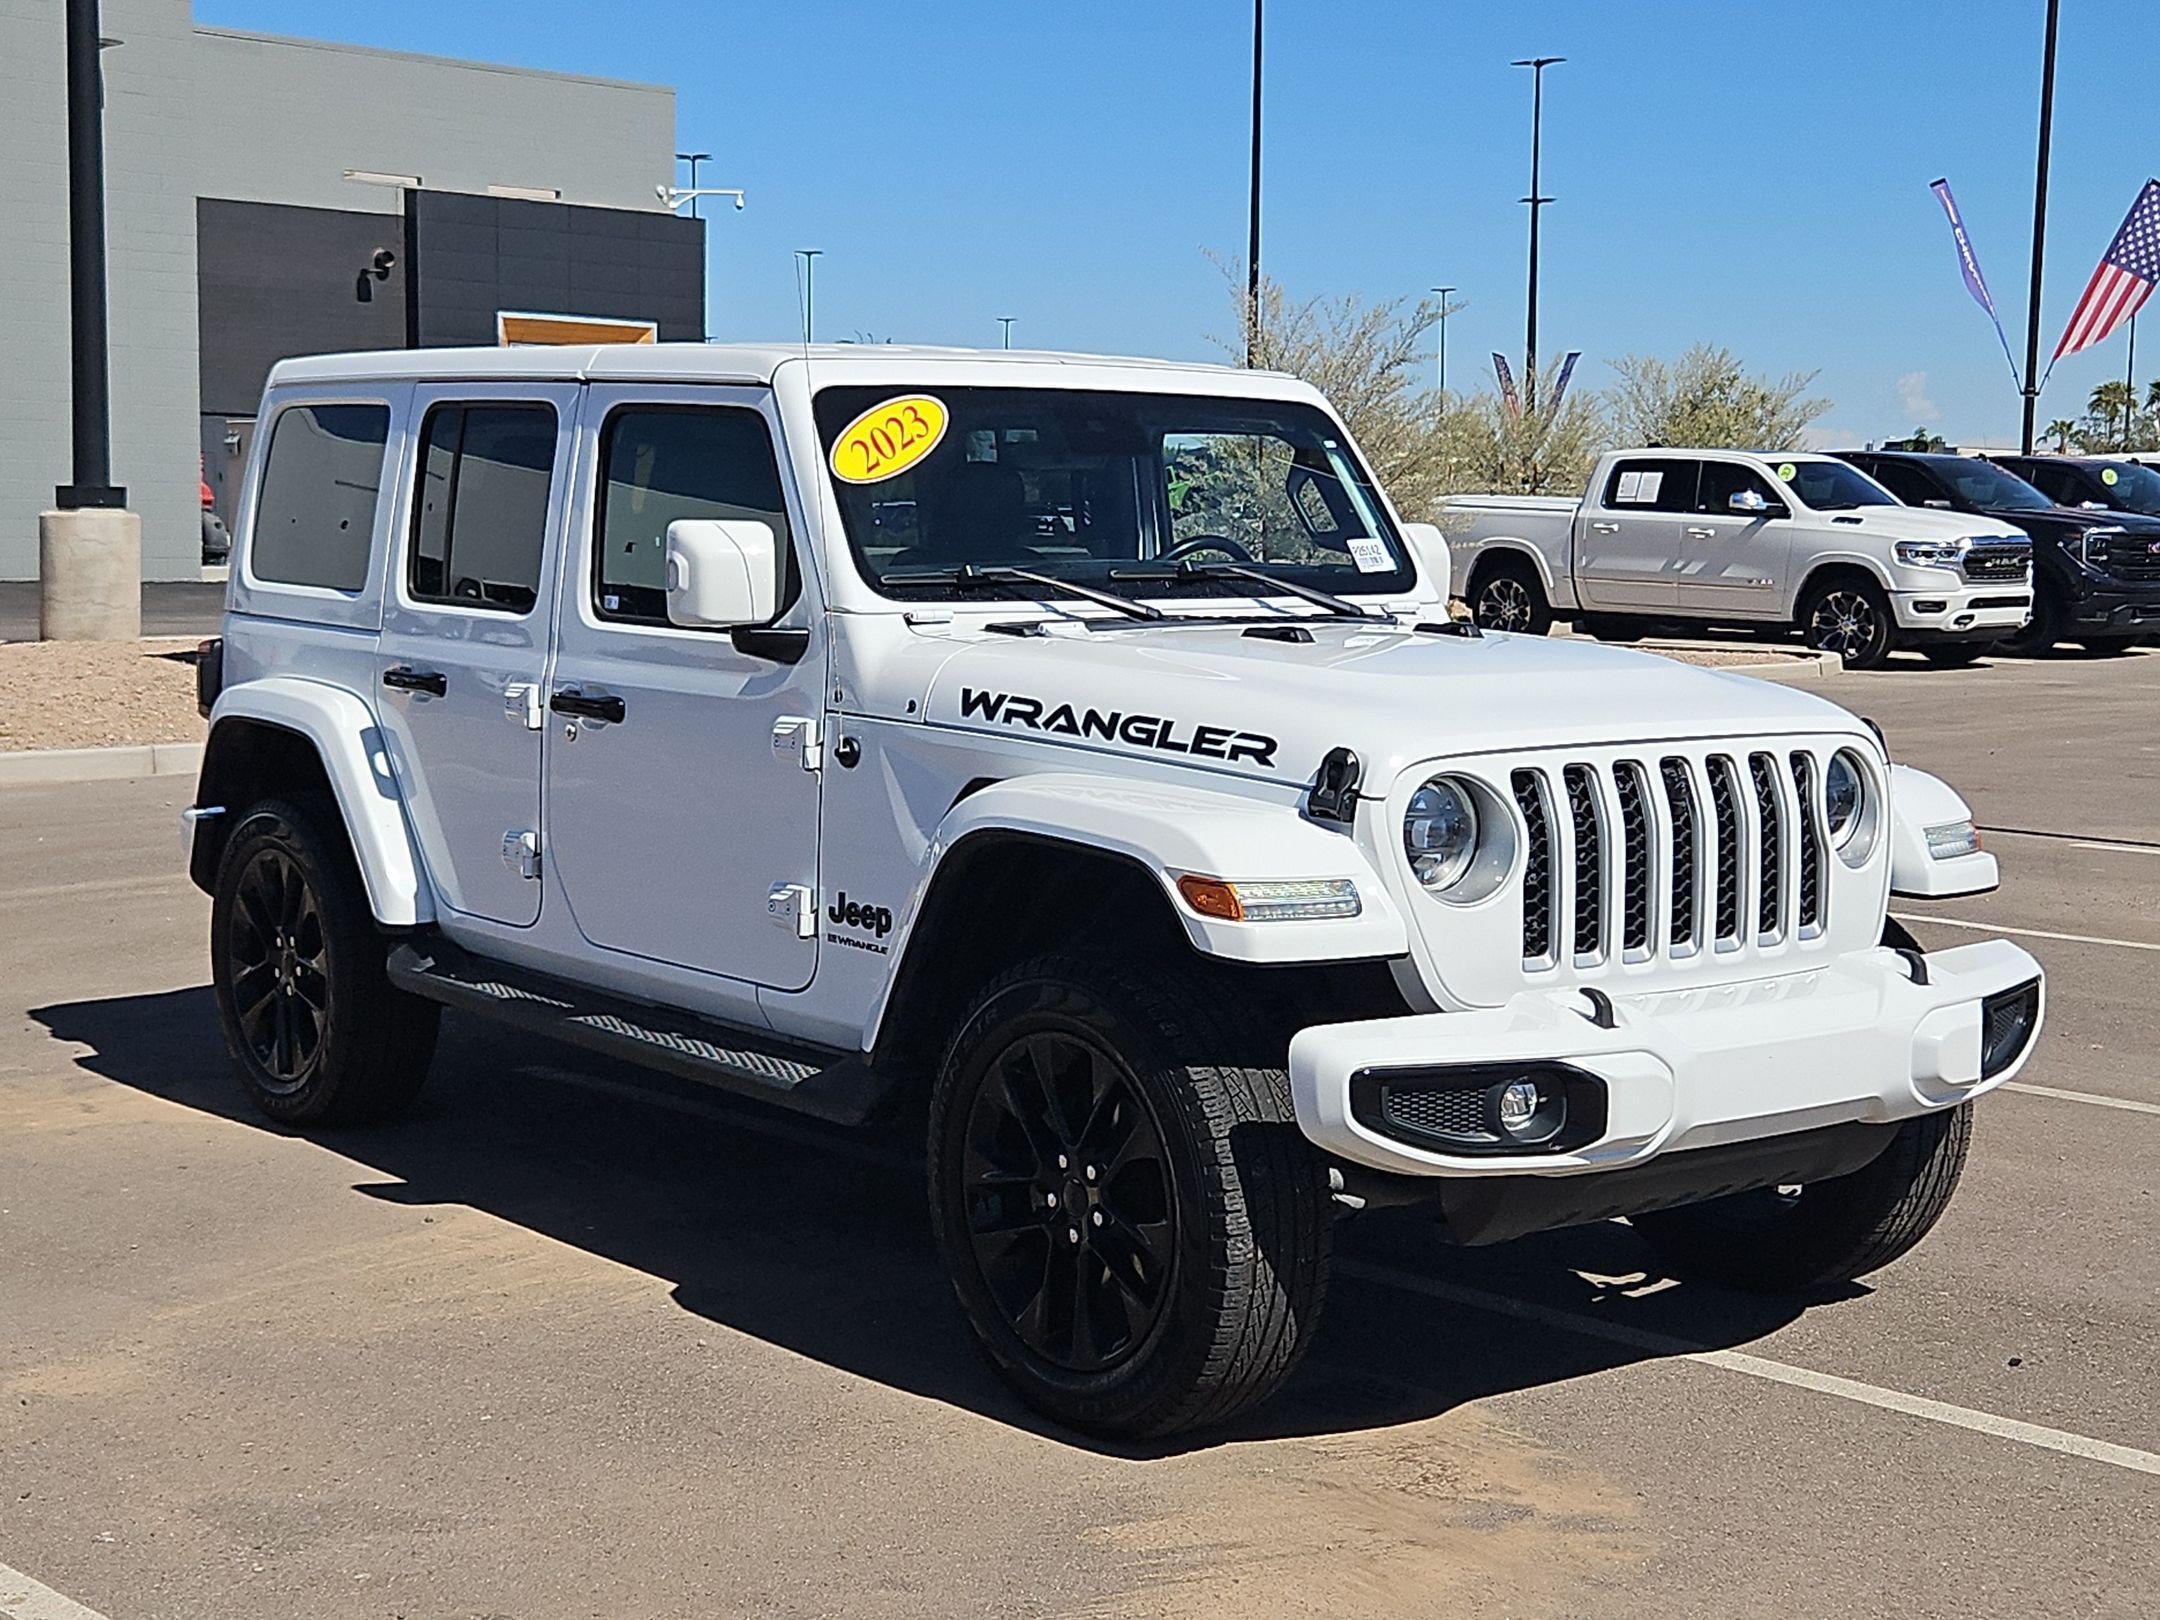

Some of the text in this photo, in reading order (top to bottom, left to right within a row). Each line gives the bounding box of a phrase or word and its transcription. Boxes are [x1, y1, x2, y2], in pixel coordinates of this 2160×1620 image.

[850, 405, 929, 474] 2023
[960, 687, 1278, 768] WRANGLER
[828, 891, 892, 939] Jeep
